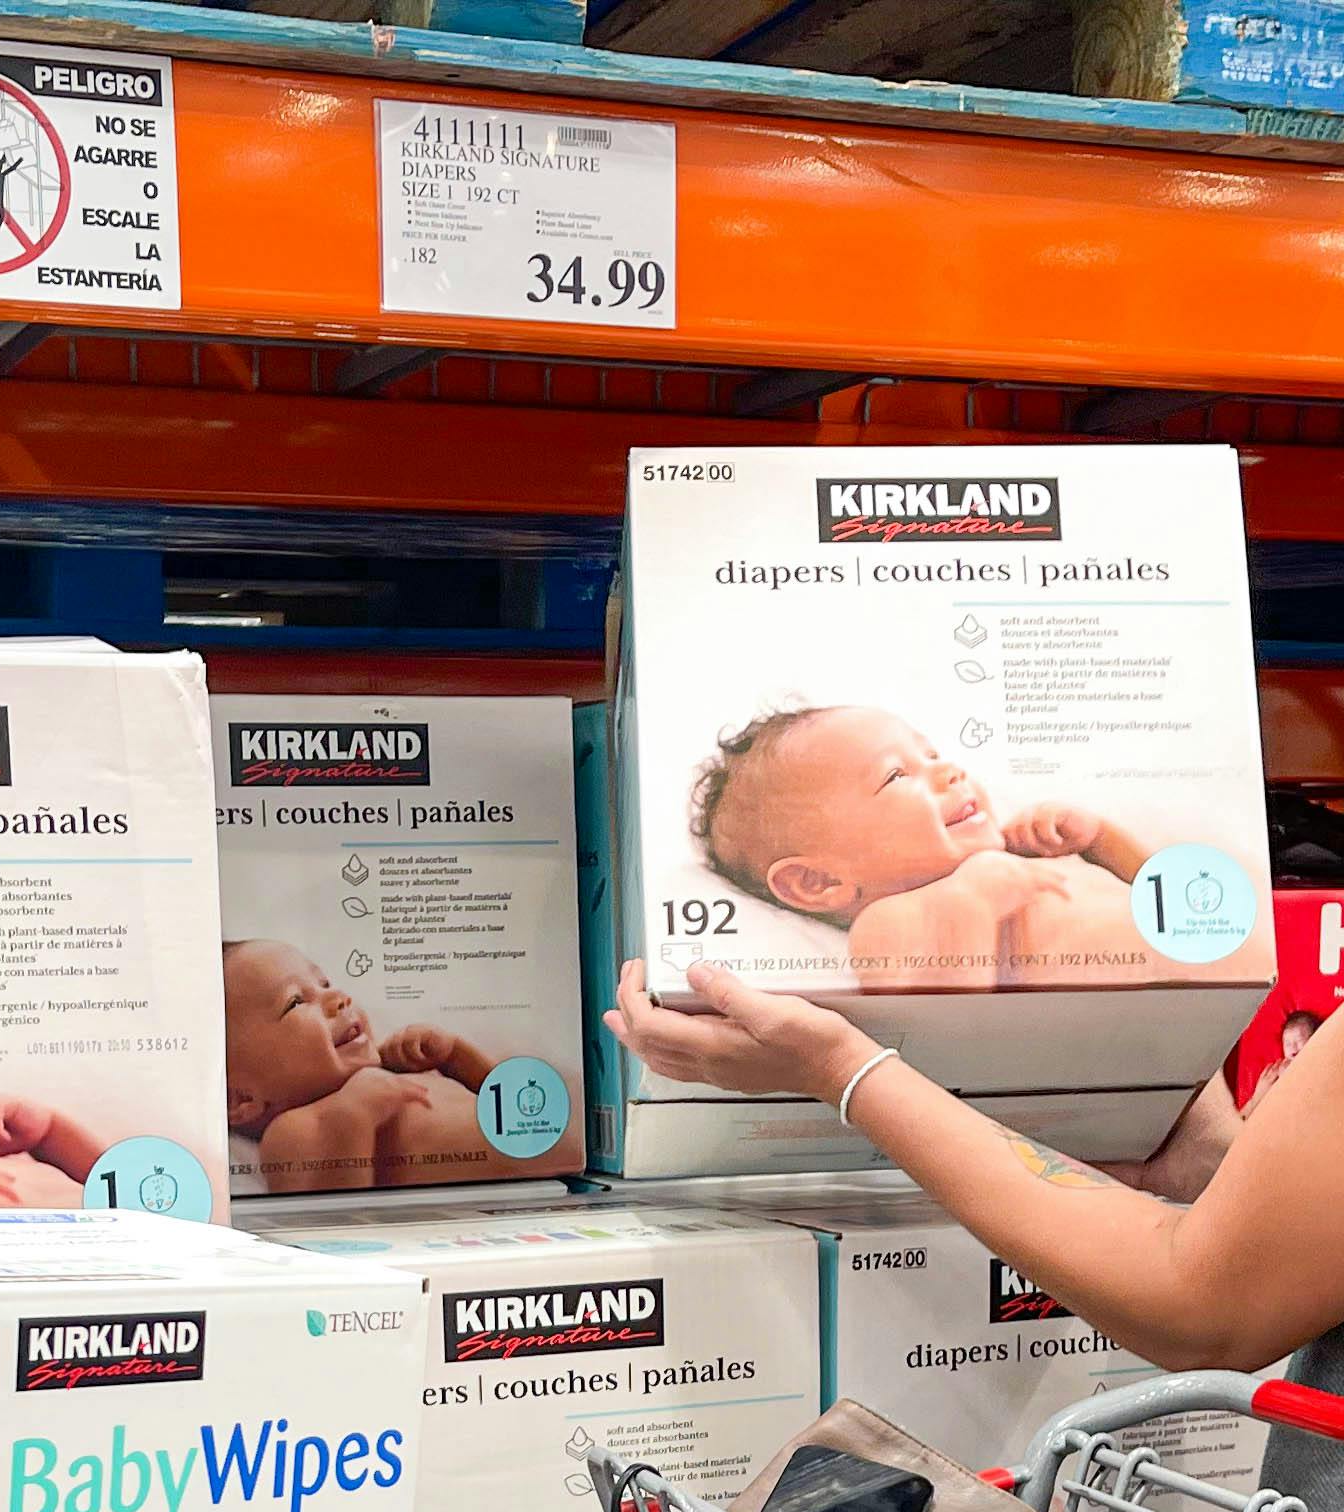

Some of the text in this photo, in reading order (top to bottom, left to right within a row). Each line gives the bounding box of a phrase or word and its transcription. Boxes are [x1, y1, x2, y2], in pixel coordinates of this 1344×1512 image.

[34, 65, 156, 99] PELIGRO
[95, 115, 156, 137] NO SE
[413, 115, 526, 151] 4111111
[74, 145, 158, 169] AGARRE
[401, 142, 601, 173] KIRKLAND SIGNATURE
[401, 161, 476, 182] DIAPERS
[143, 182, 158, 199] O
[401, 181, 521, 205] SIZE 1 192 CT
[82, 208, 160, 230] ESCALE
[135, 242, 161, 261] LA
[404, 248, 437, 265] .182
[37, 266, 162, 292] ESTANTERÍA
[526, 253, 666, 310] 34.99
[829, 483, 1052, 518] KIRKLAND
[831, 514, 1053, 543] Signature
[714, 554, 1171, 591] diapers couches pañales
[241, 728, 422, 761] KIRKLAND
[241, 760, 424, 787] Signature
[276, 798, 514, 829] couches pañales
[661, 898, 739, 937] 192
[1146, 873, 1166, 934] 1
[137, 1038, 188, 1051] 538612
[99, 1171, 119, 1208] 1
[455, 1286, 656, 1335] KIRKLAND
[27, 1320, 199, 1361] KIRKLAND
[26, 1358, 198, 1390] Signature
[493, 1354, 757, 1402] couches pañales
